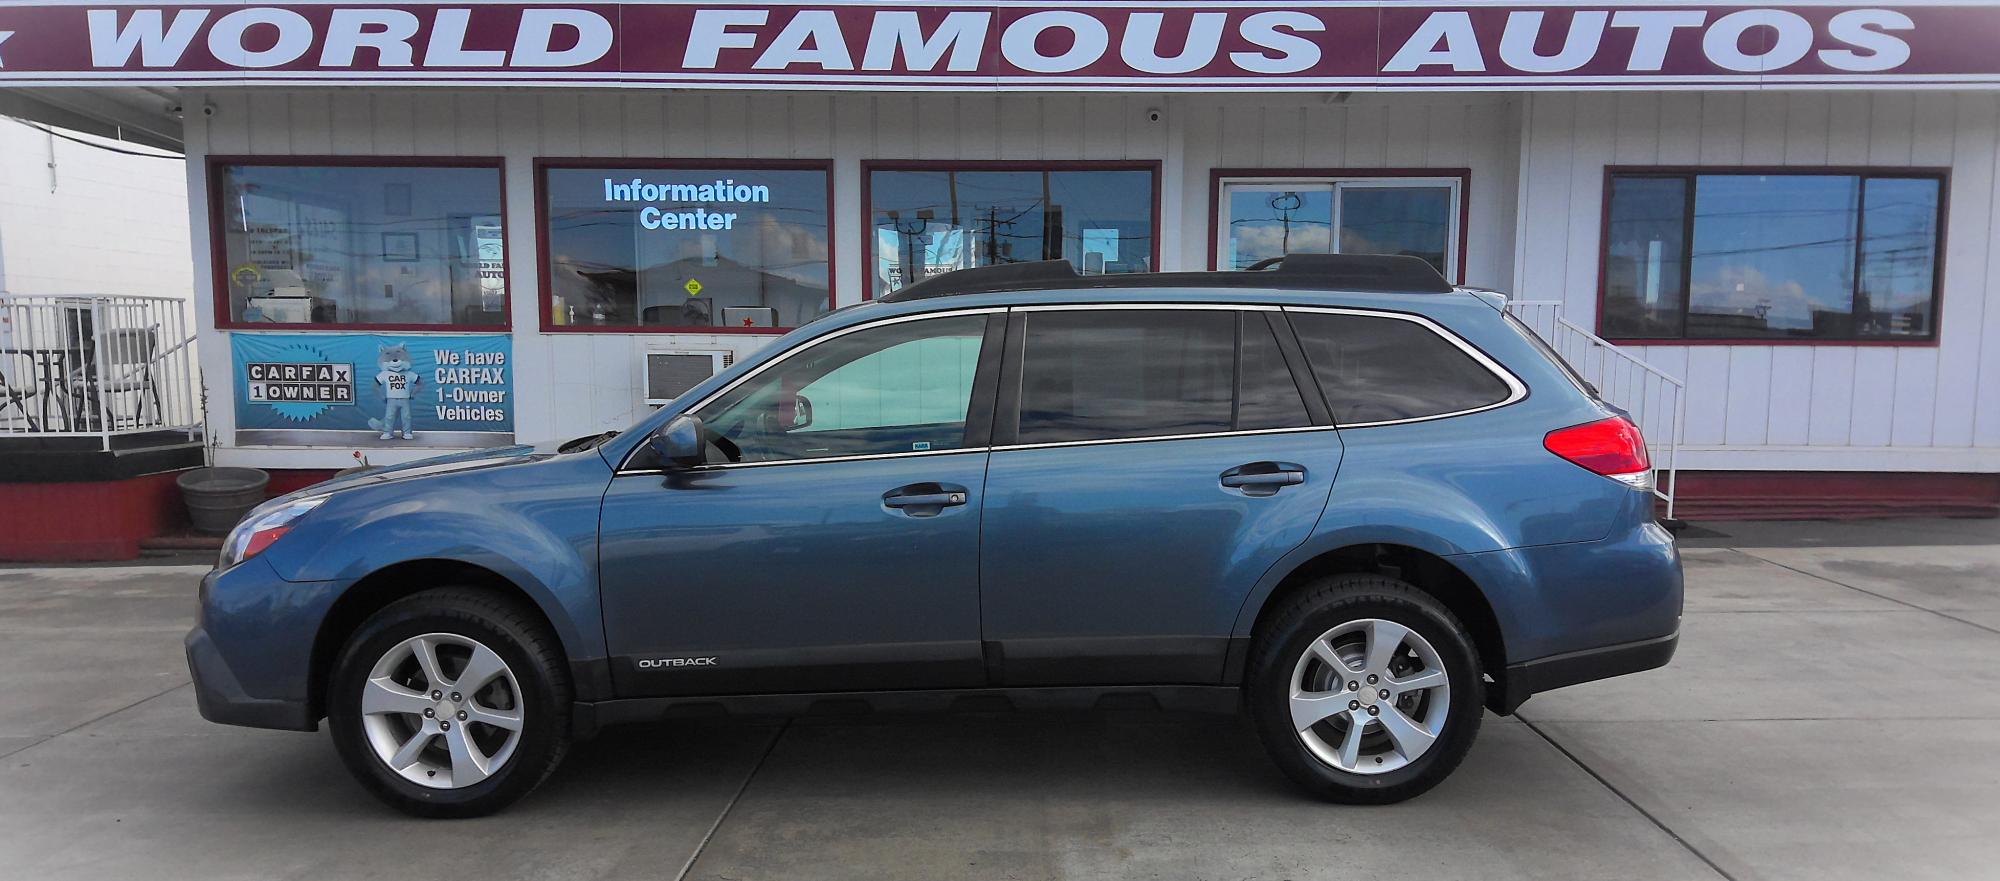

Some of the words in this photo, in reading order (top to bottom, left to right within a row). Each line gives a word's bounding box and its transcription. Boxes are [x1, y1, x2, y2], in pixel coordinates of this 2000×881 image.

[87, 8, 614, 69] WORLD
[681, 9, 1326, 73] FAMOUS
[1381, 8, 1916, 73] AUTOS
[604, 178, 769, 202] Information
[640, 206, 737, 230] Center
[434, 349, 460, 365] We
[464, 349, 505, 365] have
[251, 365, 348, 382] CARFAX
[388, 375, 406, 383] CAR
[434, 367, 505, 385] CARFAX
[390, 382, 406, 390] FOX
[436, 387, 506, 403] 1-Owner
[436, 405, 504, 421] Vehicles
[638, 657, 718, 668] OUTBACK
